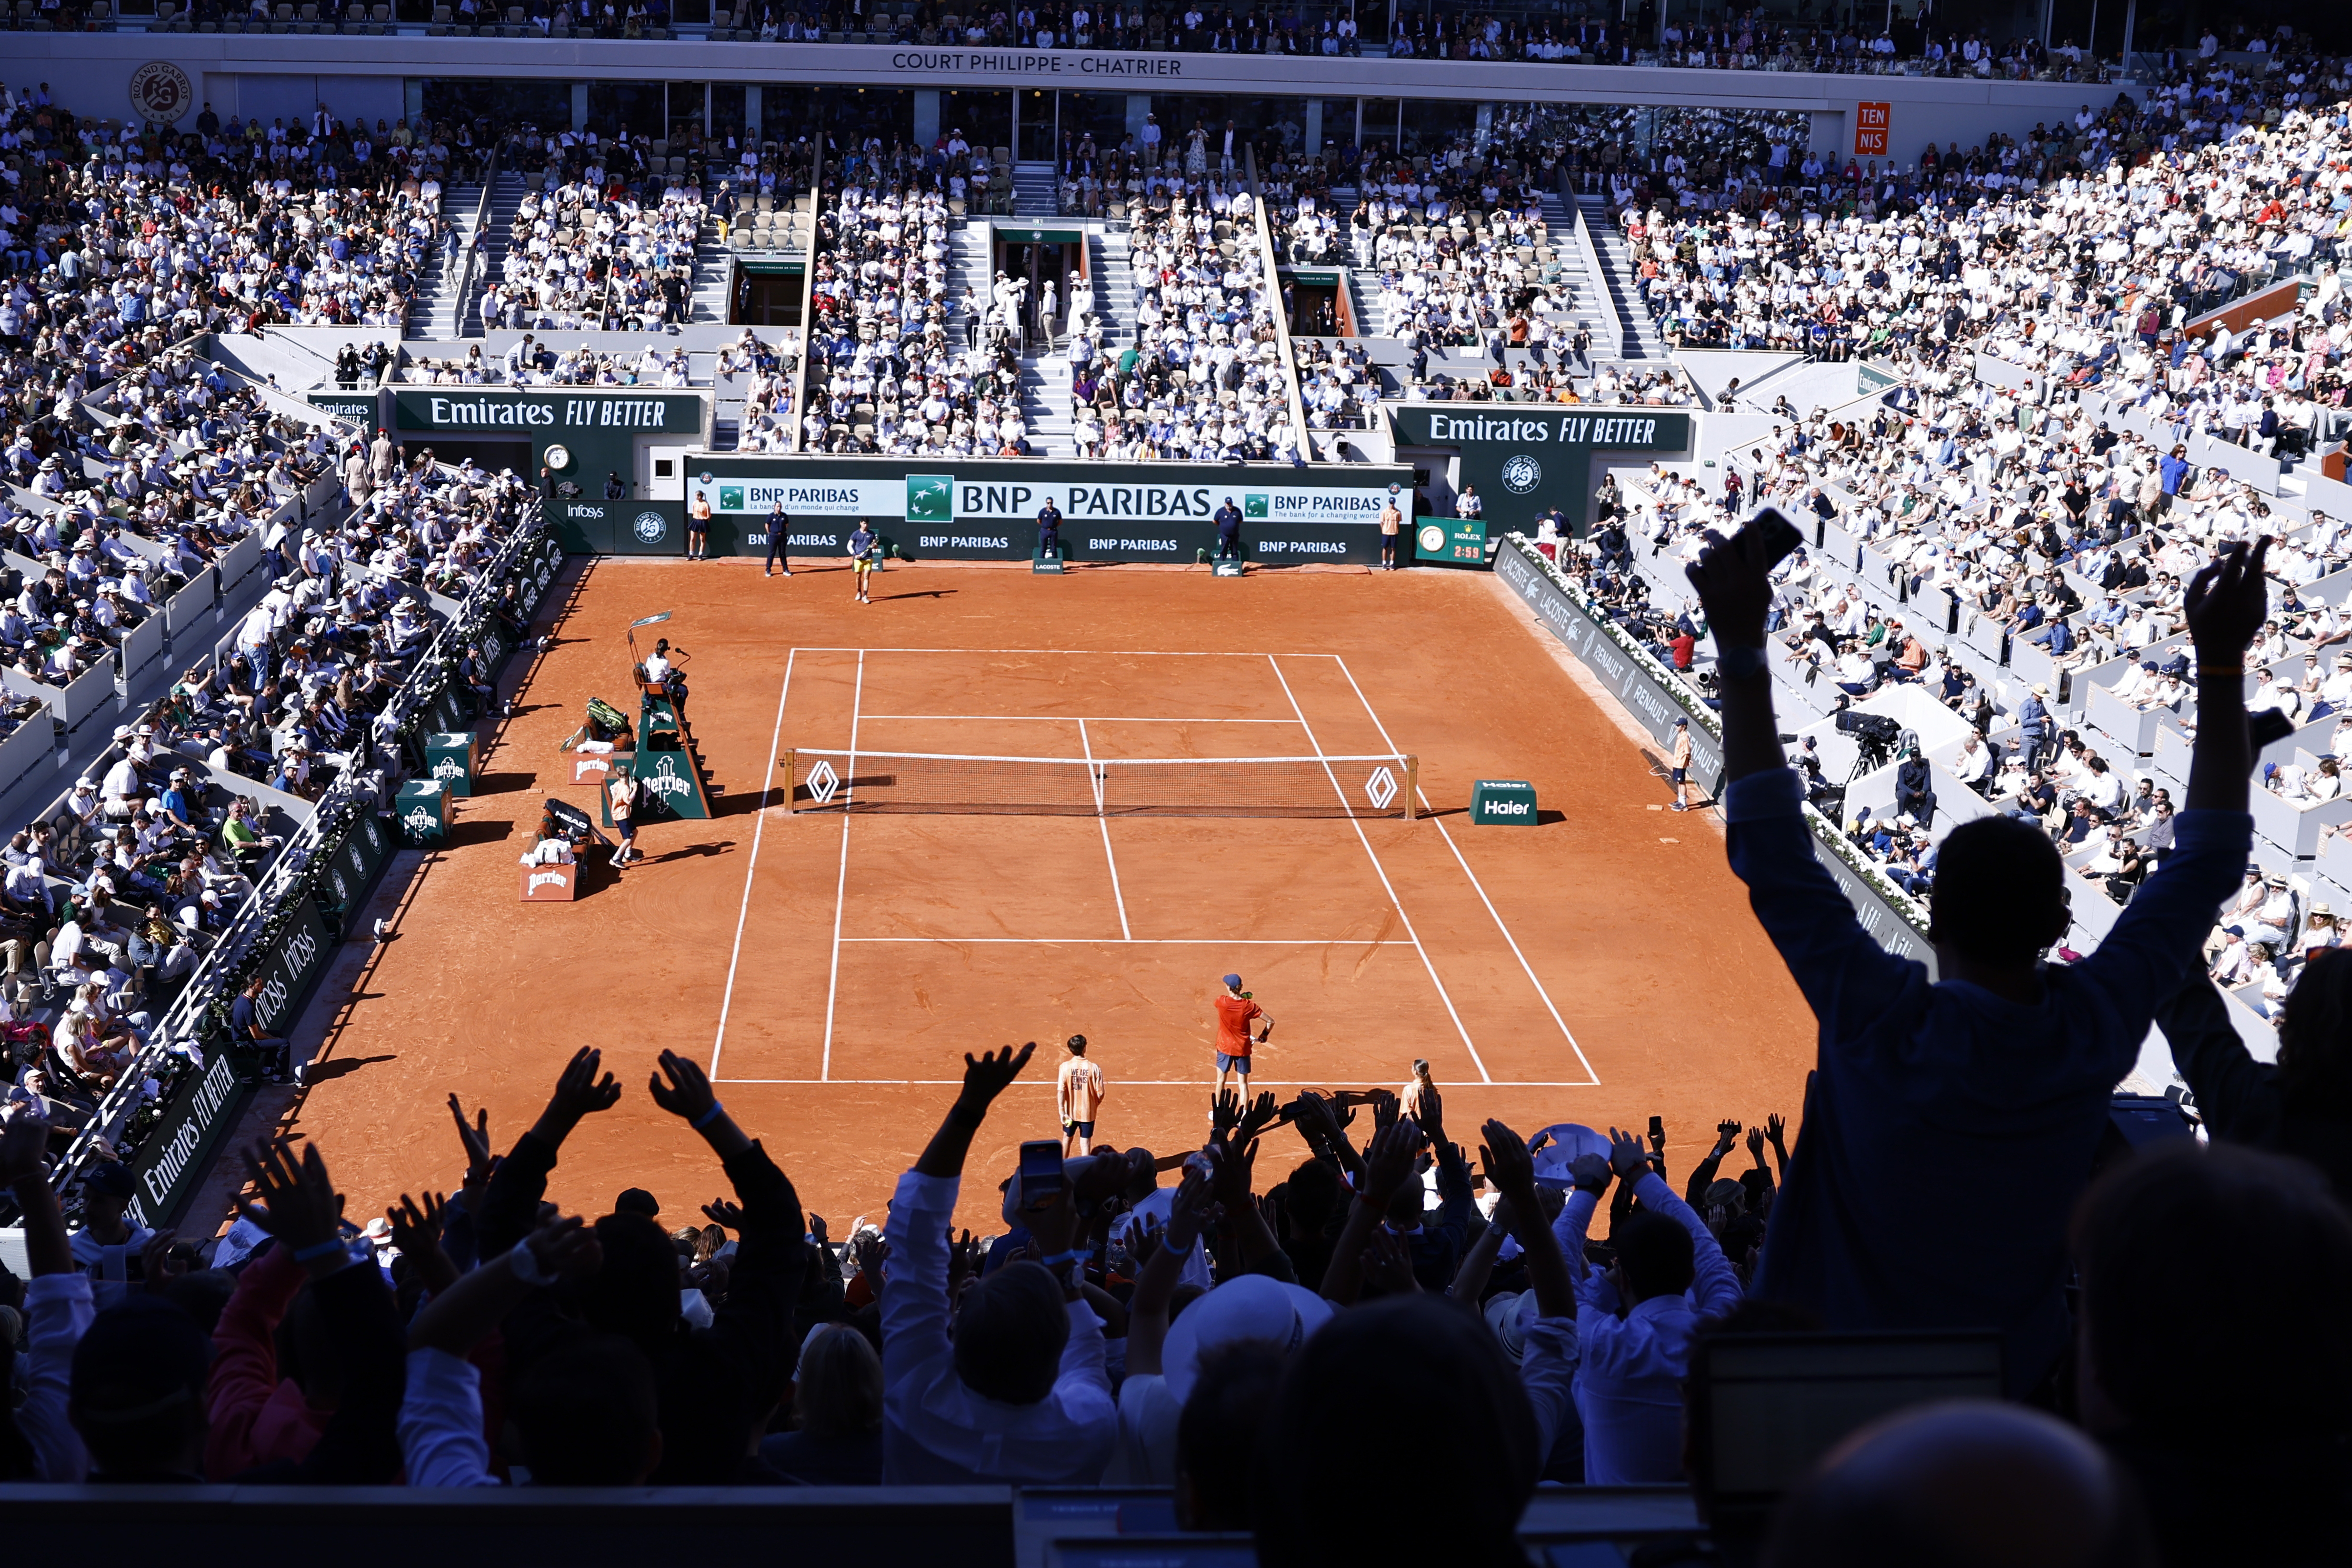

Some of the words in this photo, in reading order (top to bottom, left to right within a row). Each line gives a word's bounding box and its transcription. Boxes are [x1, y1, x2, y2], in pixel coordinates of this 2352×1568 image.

[892, 53, 964, 70] COURT
[970, 55, 1061, 72] PHILIPPE
[1080, 57, 1181, 75] CHATRIER
[133, 65, 158, 99] ROLAND
[162, 65, 189, 100] GARROS
[143, 108, 180, 120] PARIS
[1862, 109, 1884, 124] TEN
[1860, 133, 1882, 149] NIS
[2301, 287, 2312, 299] BN
[1859, 373, 1881, 392] Emirates
[314, 402, 368, 414] Emirates
[430, 397, 554, 425] Emirates
[565, 400, 596, 426] FLY
[600, 401, 665, 427] BETTER
[1430, 414, 1548, 441] Emirates
[1559, 417, 1590, 442] FLY
[1592, 418, 1656, 444] BETTER
[1504, 457, 1522, 479] ROLAND
[1523, 457, 1539, 479] GARROS
[750, 488, 785, 501] BNP
[789, 488, 859, 502] PARIBAS
[962, 486, 1031, 513] BNP
[1069, 487, 1210, 516] PARIBAS
[1275, 495, 1308, 510] BNP
[1313, 496, 1381, 511] PARIBAS
[567, 504, 604, 519] Infosys
[1326, 512, 1358, 520] changing
[636, 513, 649, 532] ROLAND
[650, 514, 664, 532] GARROS
[787, 534, 837, 546] ARIBAS
[920, 536, 948, 547] BNP
[951, 537, 1008, 548] PARIBAS
[1090, 538, 1117, 550] BNP
[1120, 539, 1177, 551] PARIBAS
[1259, 541, 1287, 552] BNP
[1290, 542, 1347, 553] PARIBAS
[1454, 545, 1480, 558] 2:59
[1502, 554, 1530, 589] LACOSTE
[1539, 590, 1571, 630] LACOSTE
[1593, 643, 1625, 681] RENAULT
[1633, 684, 1669, 725] RENAULT
[649, 710, 673, 728] perrier
[1686, 730, 1720, 777] ENAULT
[576, 758, 610, 781] perrier
[641, 772, 690, 808] perrier
[1484, 800, 1530, 815] Haier
[555, 811, 588, 829] HEAD
[527, 870, 567, 896] perrier
[280, 924, 316, 982] Infosys
[143, 1116, 200, 1206] Emirates
[192, 1087, 213, 1132] FLY
[203, 1053, 235, 1114] BETTER
